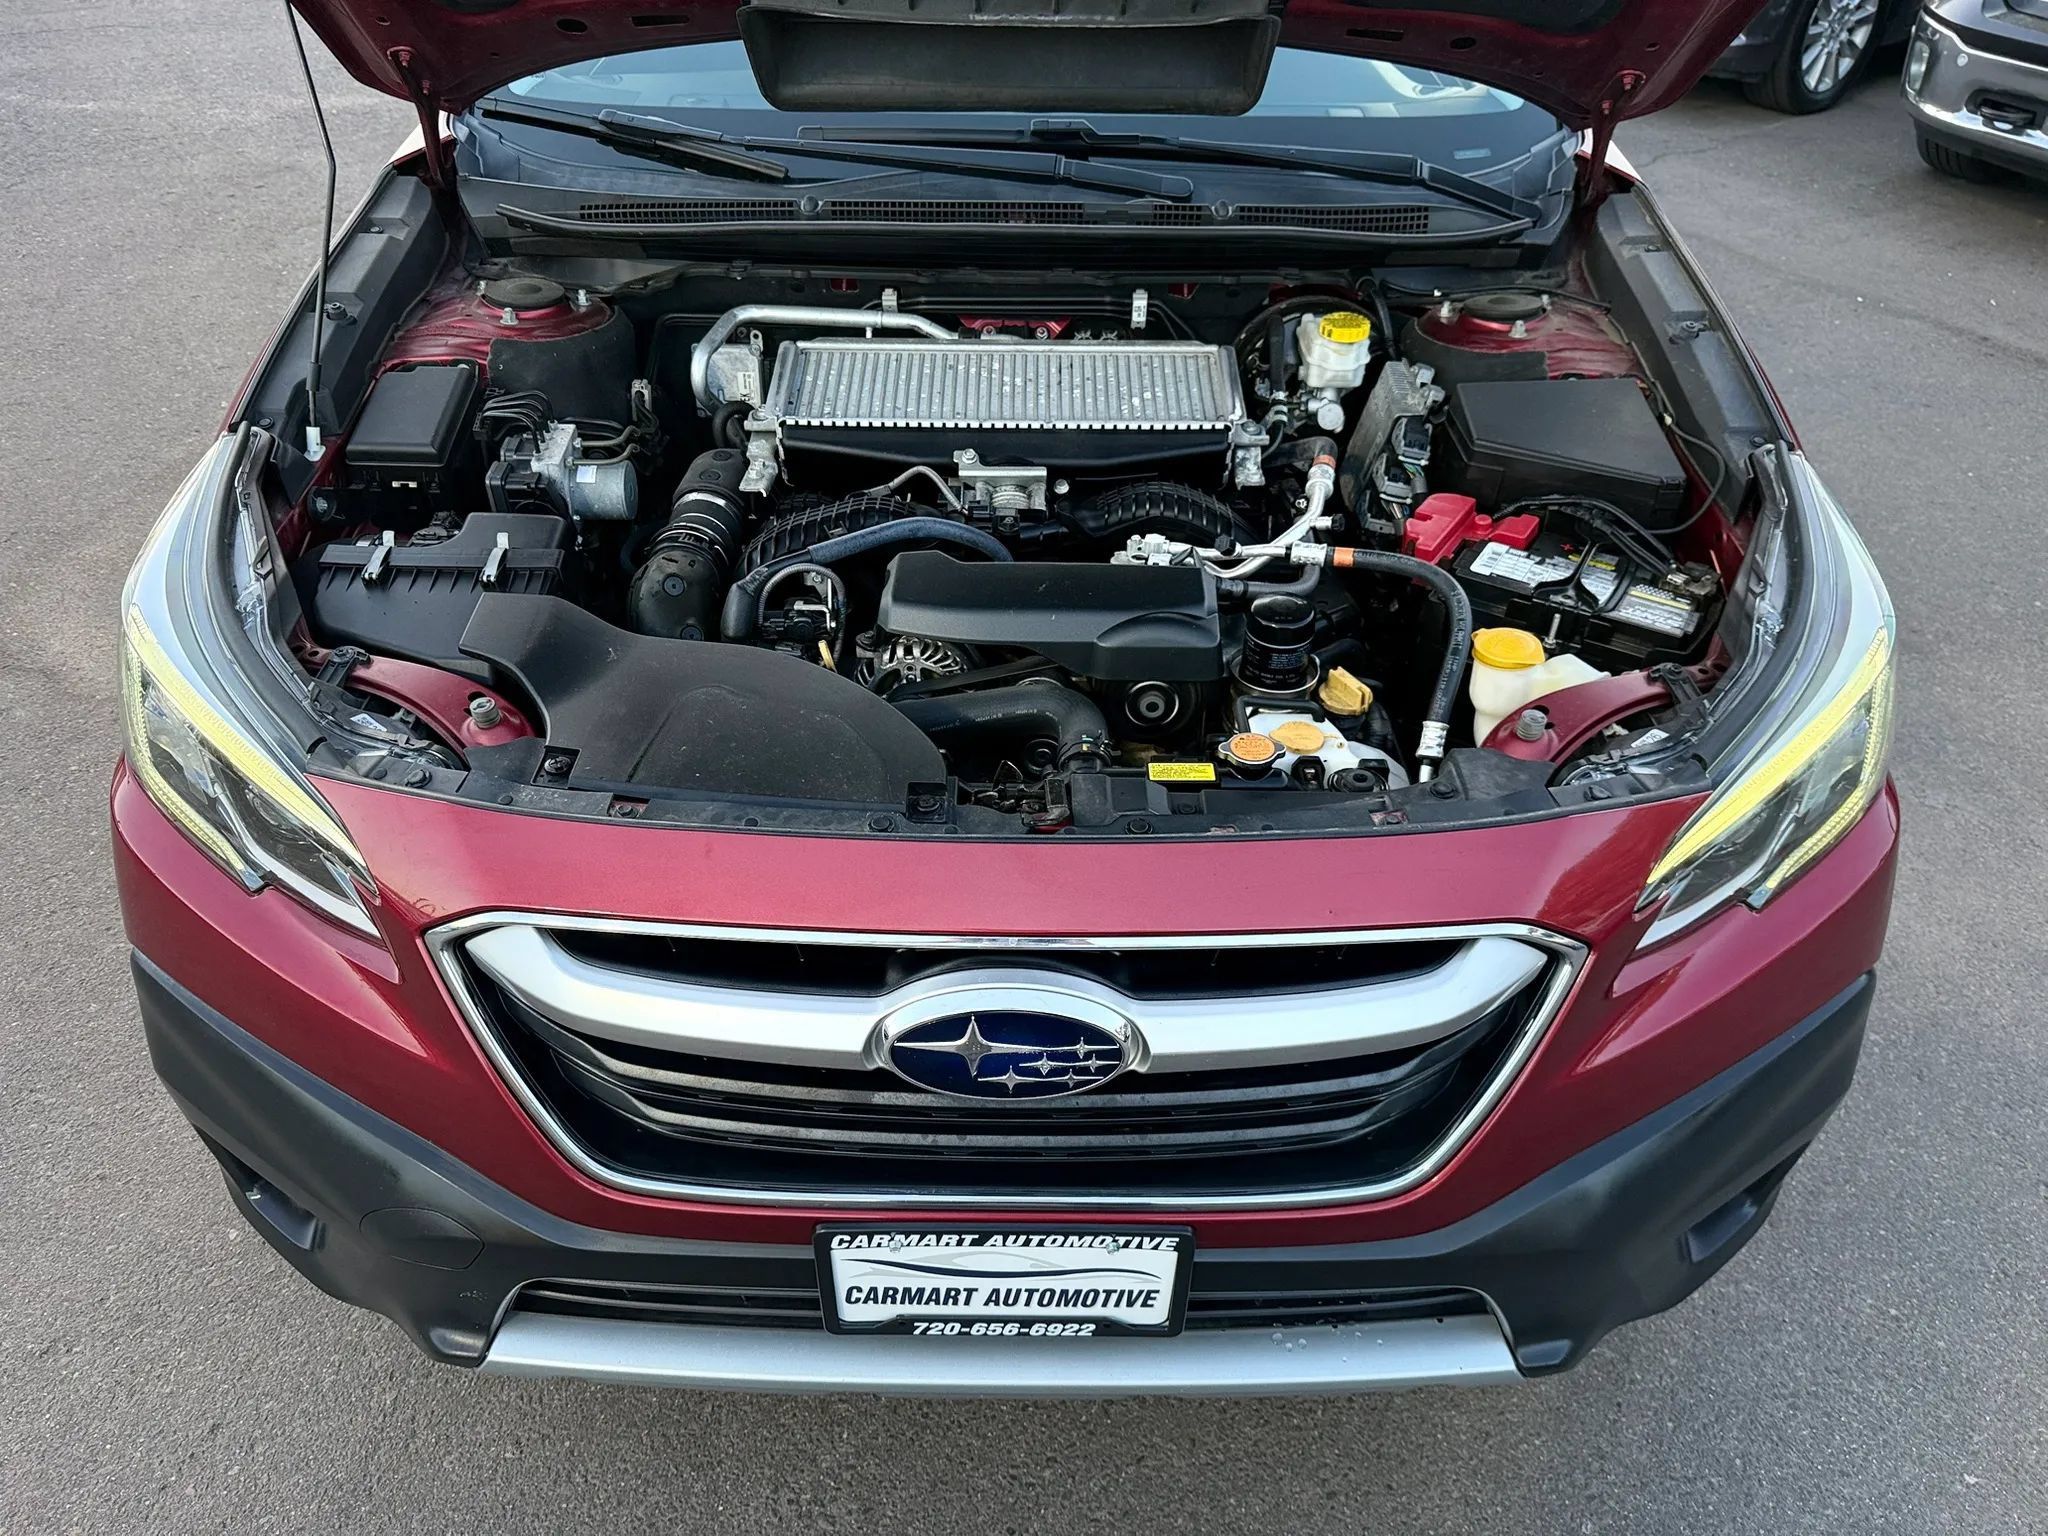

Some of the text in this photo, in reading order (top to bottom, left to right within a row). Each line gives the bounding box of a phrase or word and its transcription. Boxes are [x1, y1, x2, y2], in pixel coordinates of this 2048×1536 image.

[831, 1234, 1180, 1251] CARMART AUTOMOTIVE
[845, 1286, 1160, 1308] CARMART AUTOMOTIVE
[913, 1321, 1097, 1337] 720-656-6922
